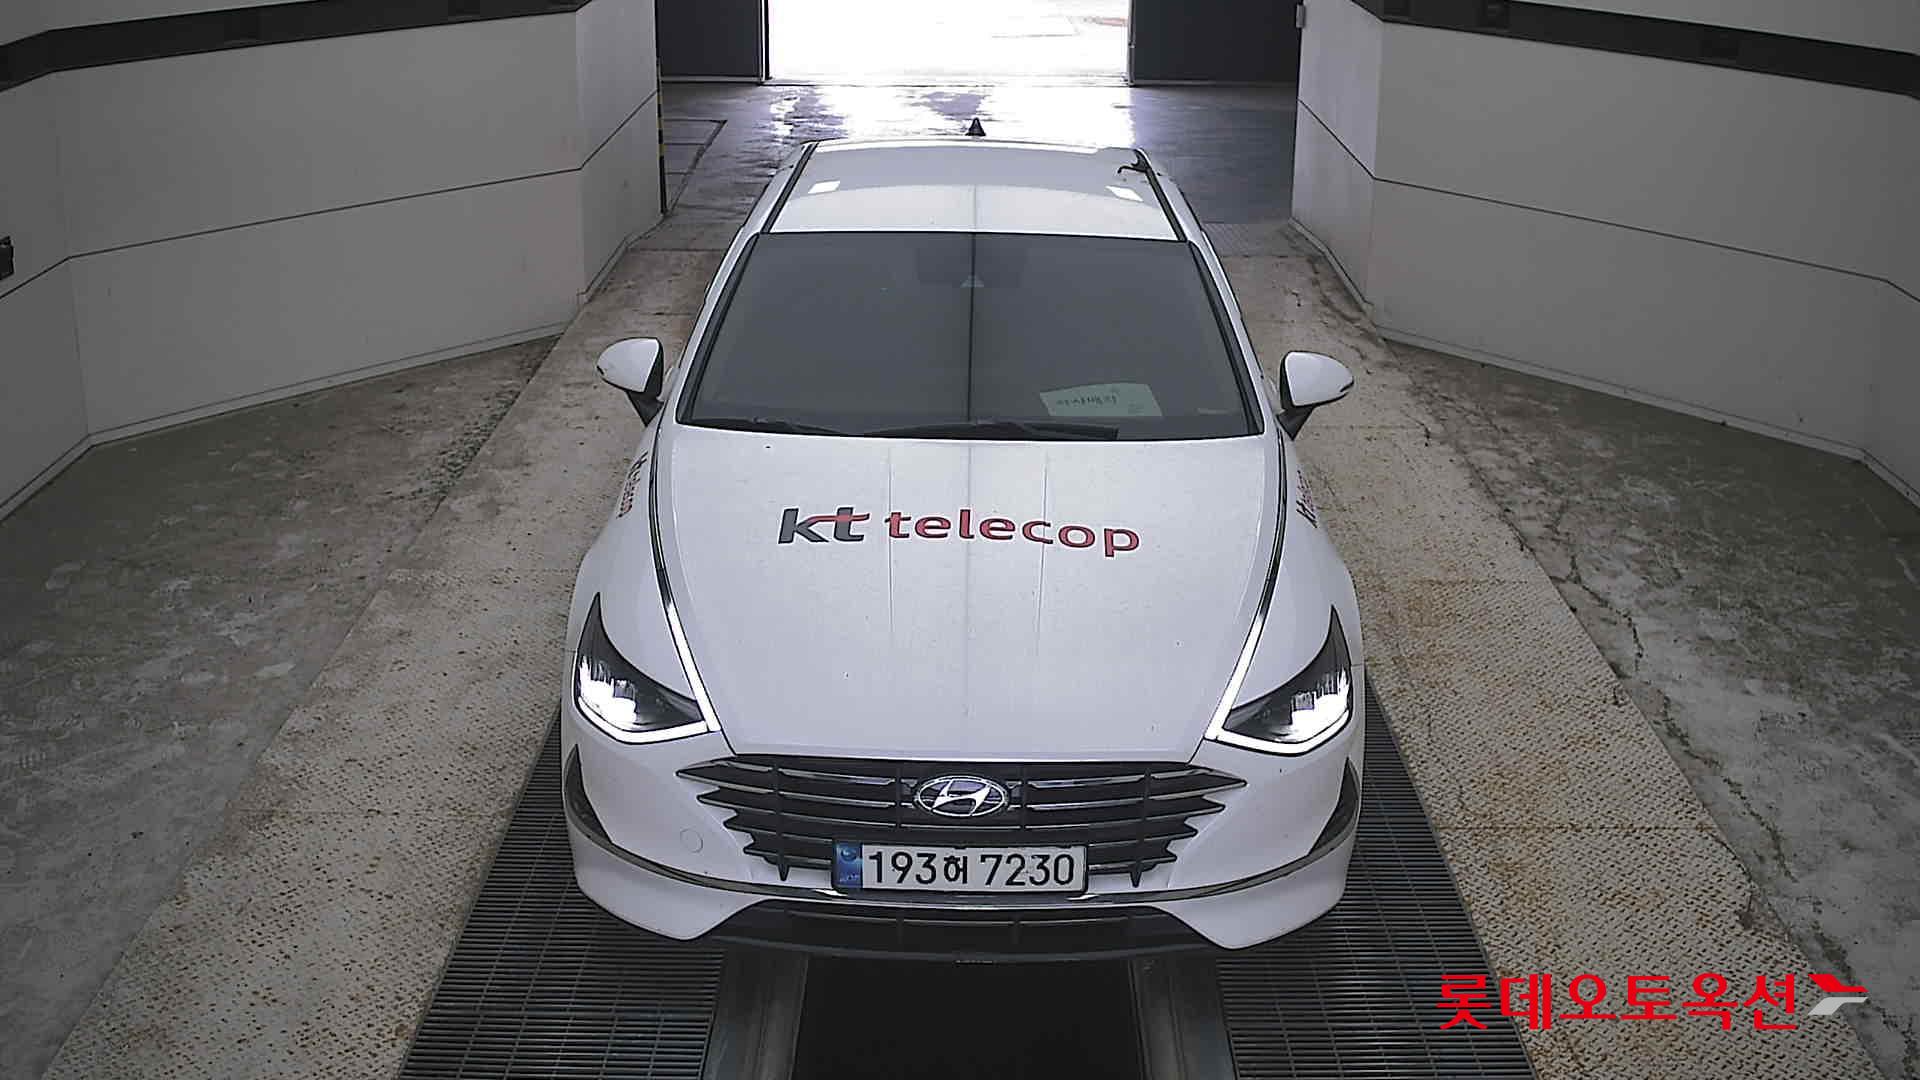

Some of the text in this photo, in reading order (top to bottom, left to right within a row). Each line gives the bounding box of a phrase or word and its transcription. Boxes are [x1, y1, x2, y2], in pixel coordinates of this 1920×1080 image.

[778, 506, 1140, 557] kt telecop
[868, 851, 1074, 886] 193허 7230
